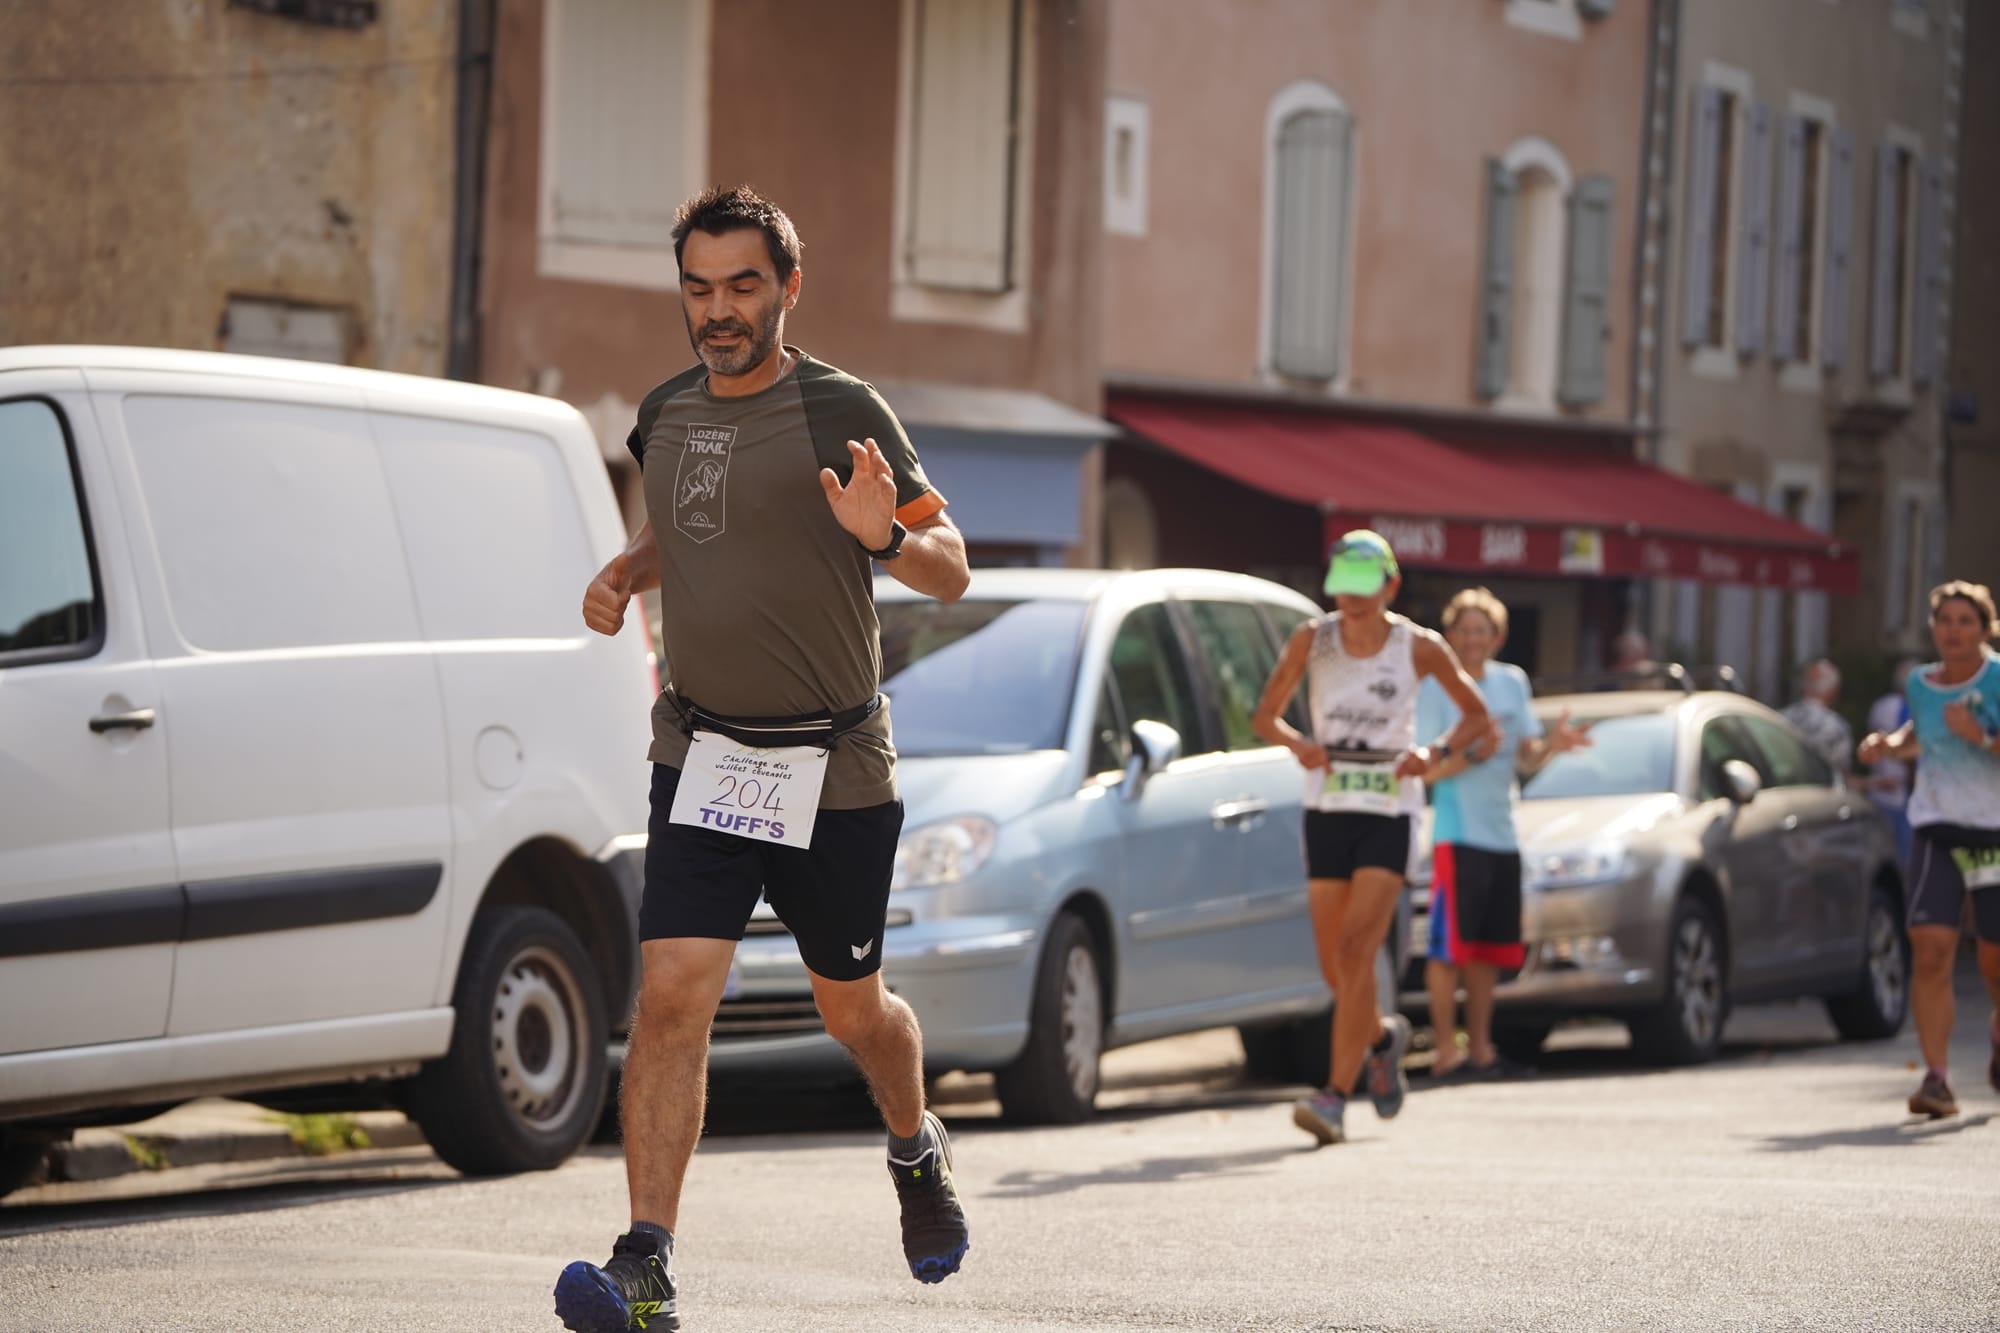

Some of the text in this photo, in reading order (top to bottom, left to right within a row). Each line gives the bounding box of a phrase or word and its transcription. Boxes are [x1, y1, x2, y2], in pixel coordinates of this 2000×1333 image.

[691, 428, 731, 441] LOZÈRE
[689, 440, 727, 455] TRAIL
[722, 754, 790, 770] Challenge des
[715, 763, 793, 780] vallées cévenoles
[1337, 770, 1390, 793] 135
[709, 775, 785, 817] 204
[699, 807, 786, 840] TUFF'S
